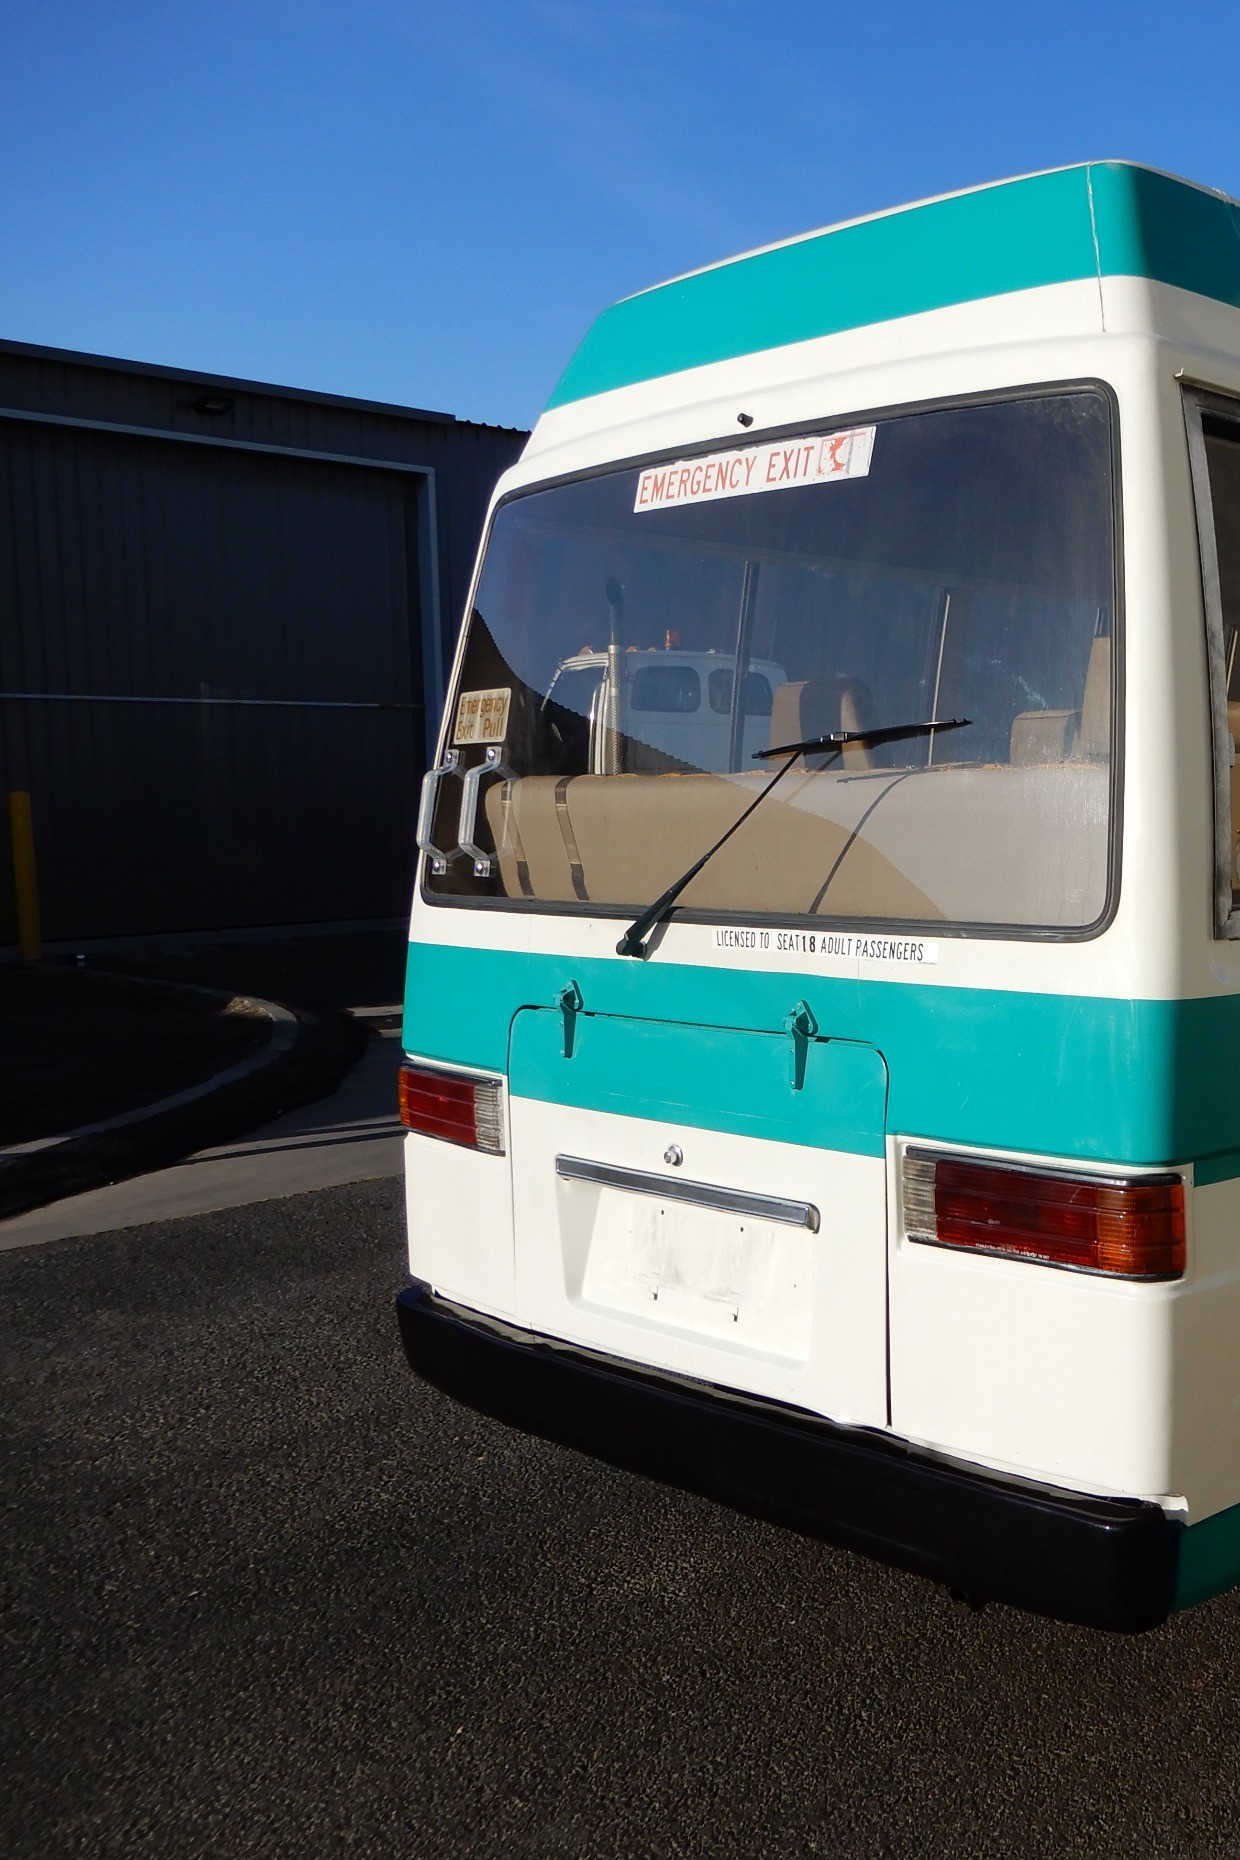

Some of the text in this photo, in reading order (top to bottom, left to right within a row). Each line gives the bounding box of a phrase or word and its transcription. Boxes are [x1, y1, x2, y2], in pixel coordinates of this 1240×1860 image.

[639, 445, 815, 506] EMERGENCY EXIT
[456, 717, 504, 740] Exit Pull
[715, 929, 924, 962] LICENSED TO SEAT 18 ADULT PASSENGERS
